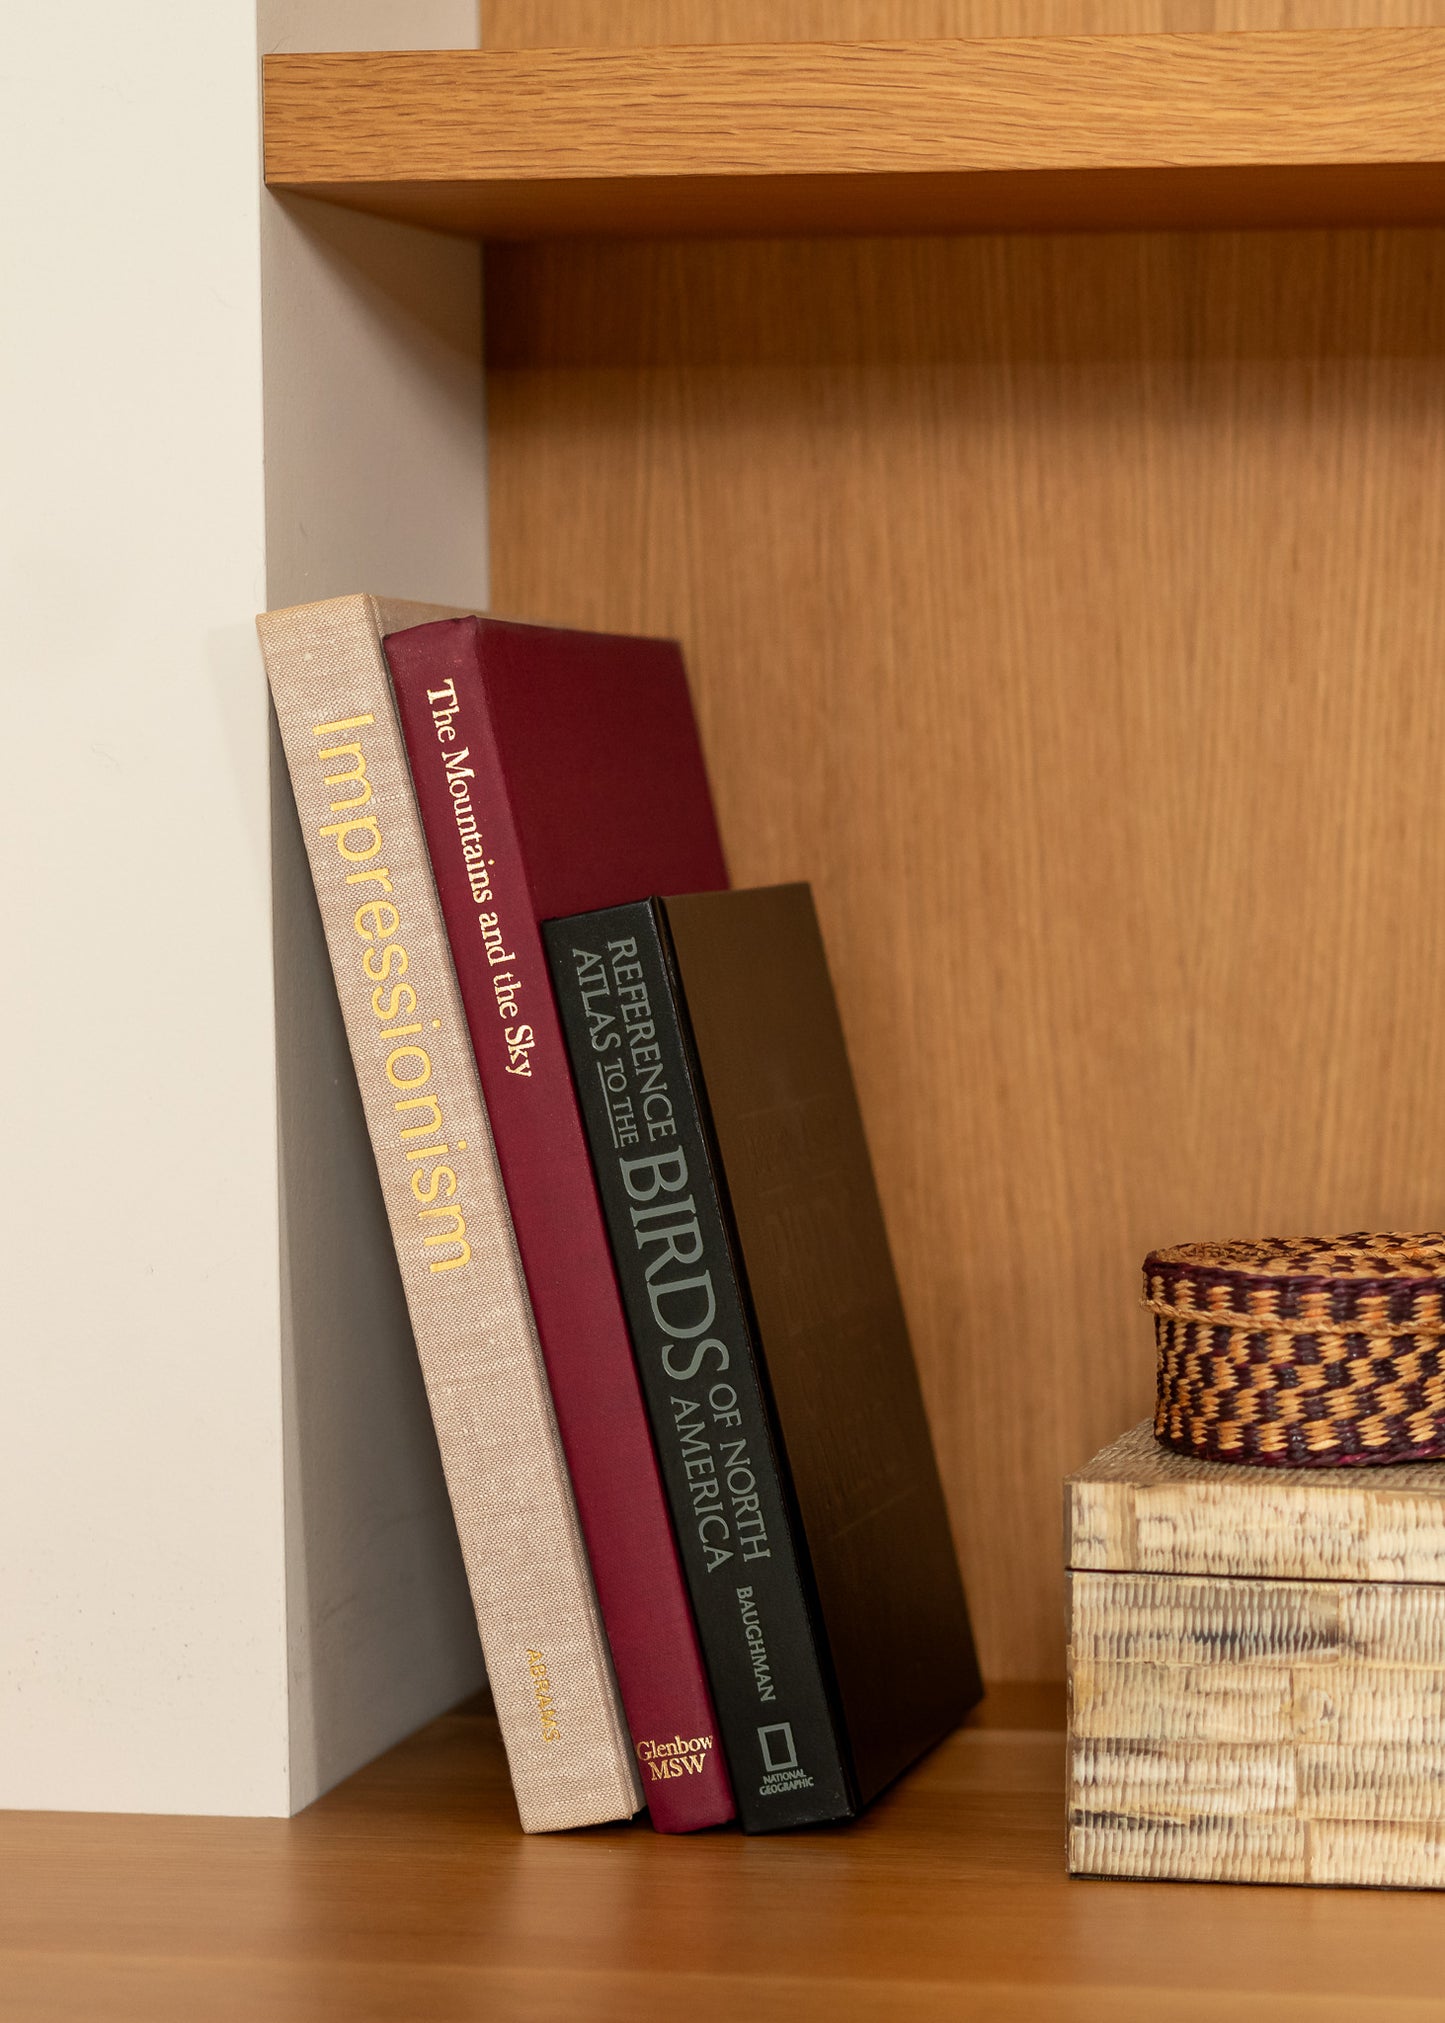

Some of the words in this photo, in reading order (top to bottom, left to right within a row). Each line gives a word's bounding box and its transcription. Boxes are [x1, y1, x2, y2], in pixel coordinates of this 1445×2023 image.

[427, 677, 459, 744] The
[441, 747, 495, 904] Mountains
[478, 911, 516, 974] and
[312, 713, 472, 1273] Impressionism
[493, 971, 522, 1020] the
[572, 948, 622, 1052] ATLAS
[504, 1024, 536, 1078] Sky
[607, 936, 677, 1142] REFERENCE
[604, 1057, 627, 1093] TO
[612, 1096, 640, 1148] THE
[618, 1144, 730, 1381] BIRDS
[708, 1383, 743, 1428] OF
[669, 1395, 735, 1574] AMERICA
[719, 1438, 772, 1563] NORTH
[735, 1585, 777, 1702] BAUGHMAN
[526, 1649, 561, 1743] ABRAMS
[637, 1735, 713, 1761] Glenbow
[648, 1753, 706, 1782] MSW
[762, 1768, 807, 1785] NATIONAL
[759, 1776, 815, 1796] GEOGRAPHIC
